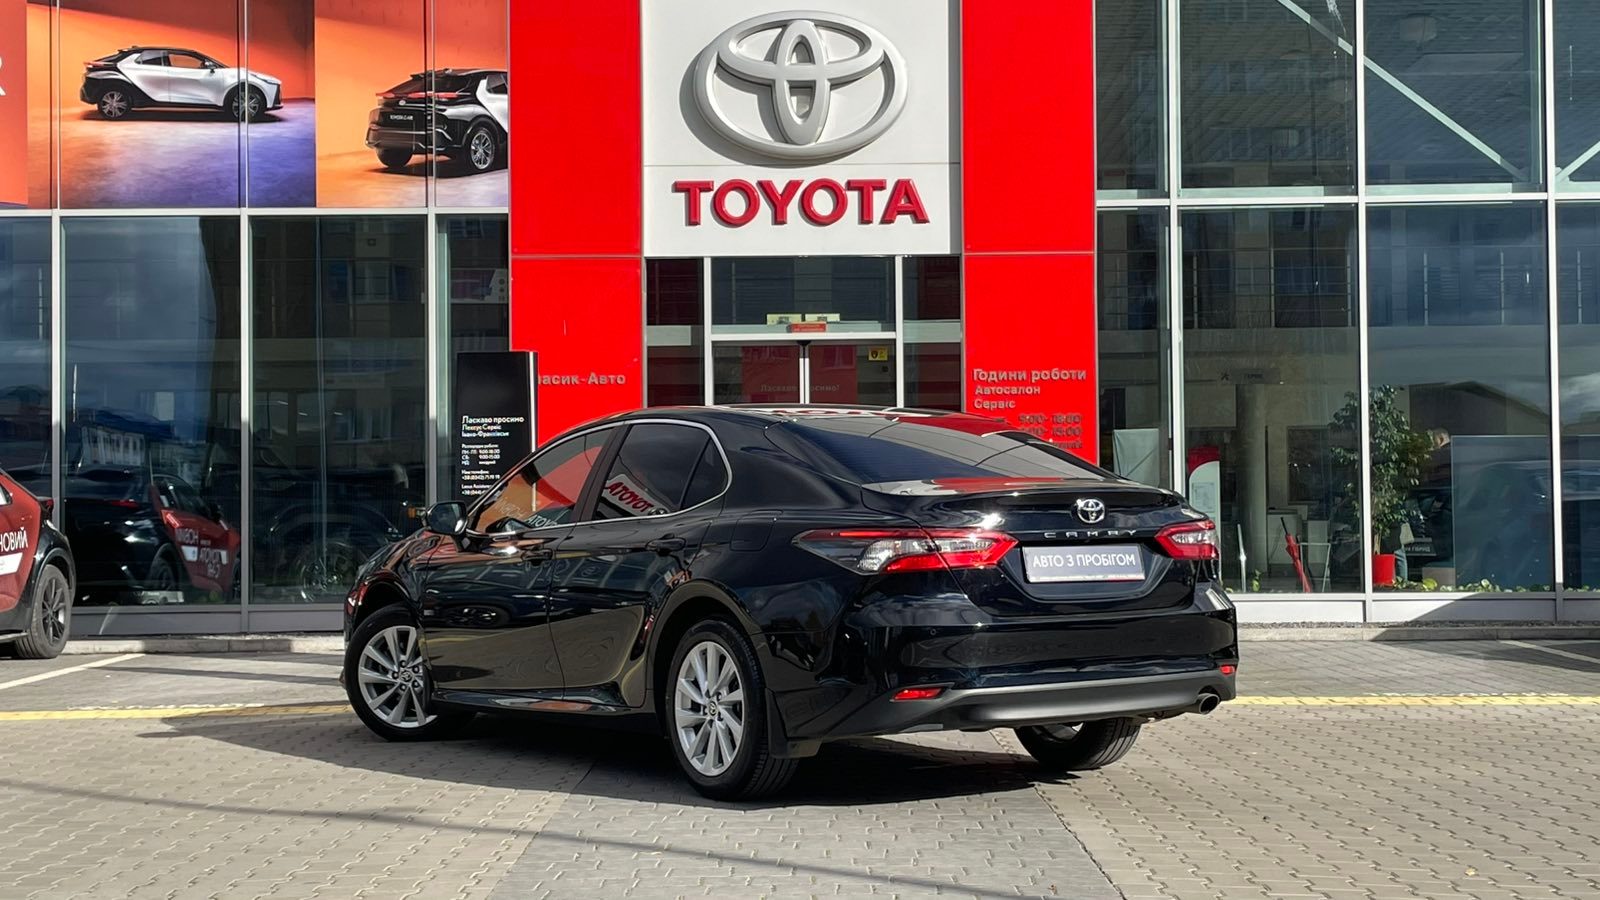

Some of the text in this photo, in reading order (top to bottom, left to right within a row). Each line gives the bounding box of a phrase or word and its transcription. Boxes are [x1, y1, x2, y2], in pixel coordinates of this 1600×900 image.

[671, 178, 931, 228] TOYOTA
[973, 368, 1086, 383] Години роботи
[975, 385, 1041, 396] Автосалон
[974, 398, 1016, 411] Сервіс
[462, 415, 525, 425] Ласкаво просимо
[1044, 529, 1137, 539] CAMRY
[1032, 554, 1064, 568] АВТО
[1077, 553, 1136, 567] ПРОБІГОМ
